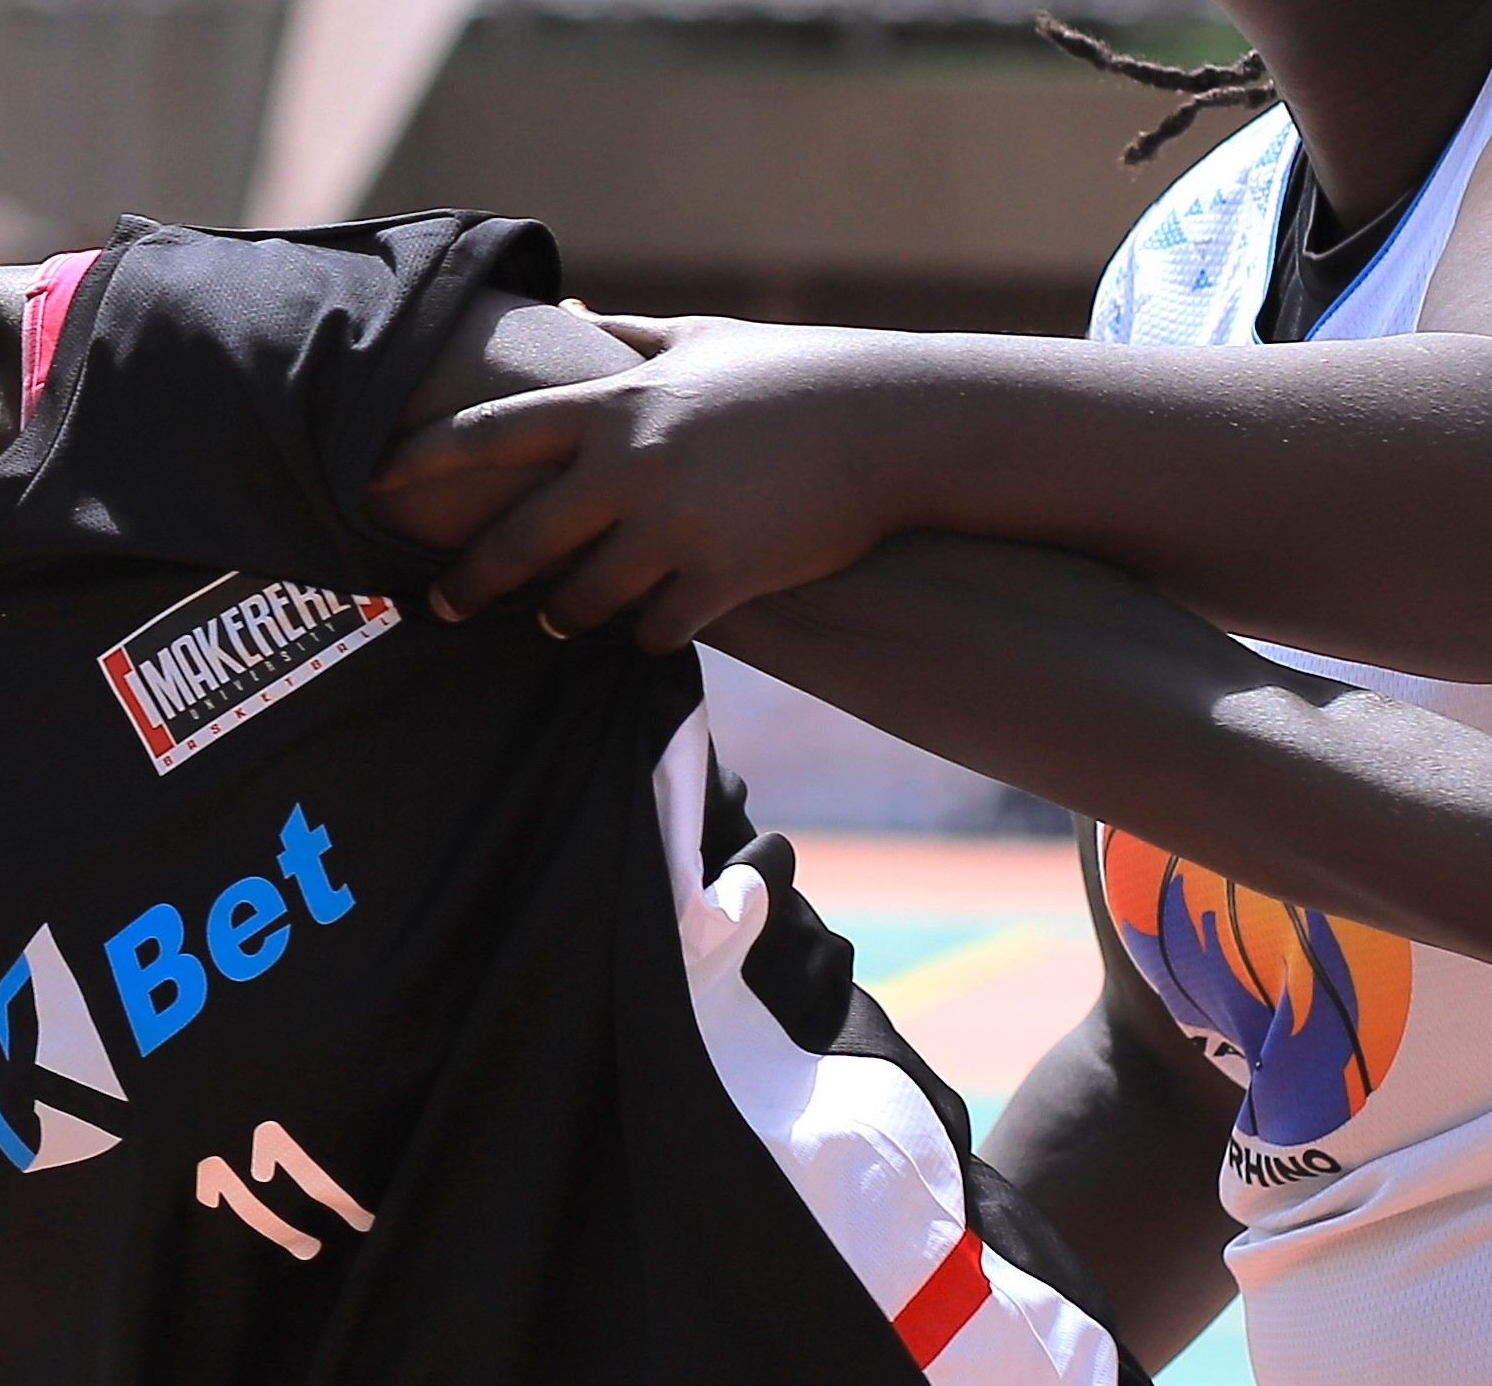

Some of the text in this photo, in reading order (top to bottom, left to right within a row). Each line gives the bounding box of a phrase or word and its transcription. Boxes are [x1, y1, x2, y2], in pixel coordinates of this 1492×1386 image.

[104, 802, 357, 1058] Bet
[196, 1120, 376, 1260] 11
[1229, 1136, 1343, 1189] RHINO
